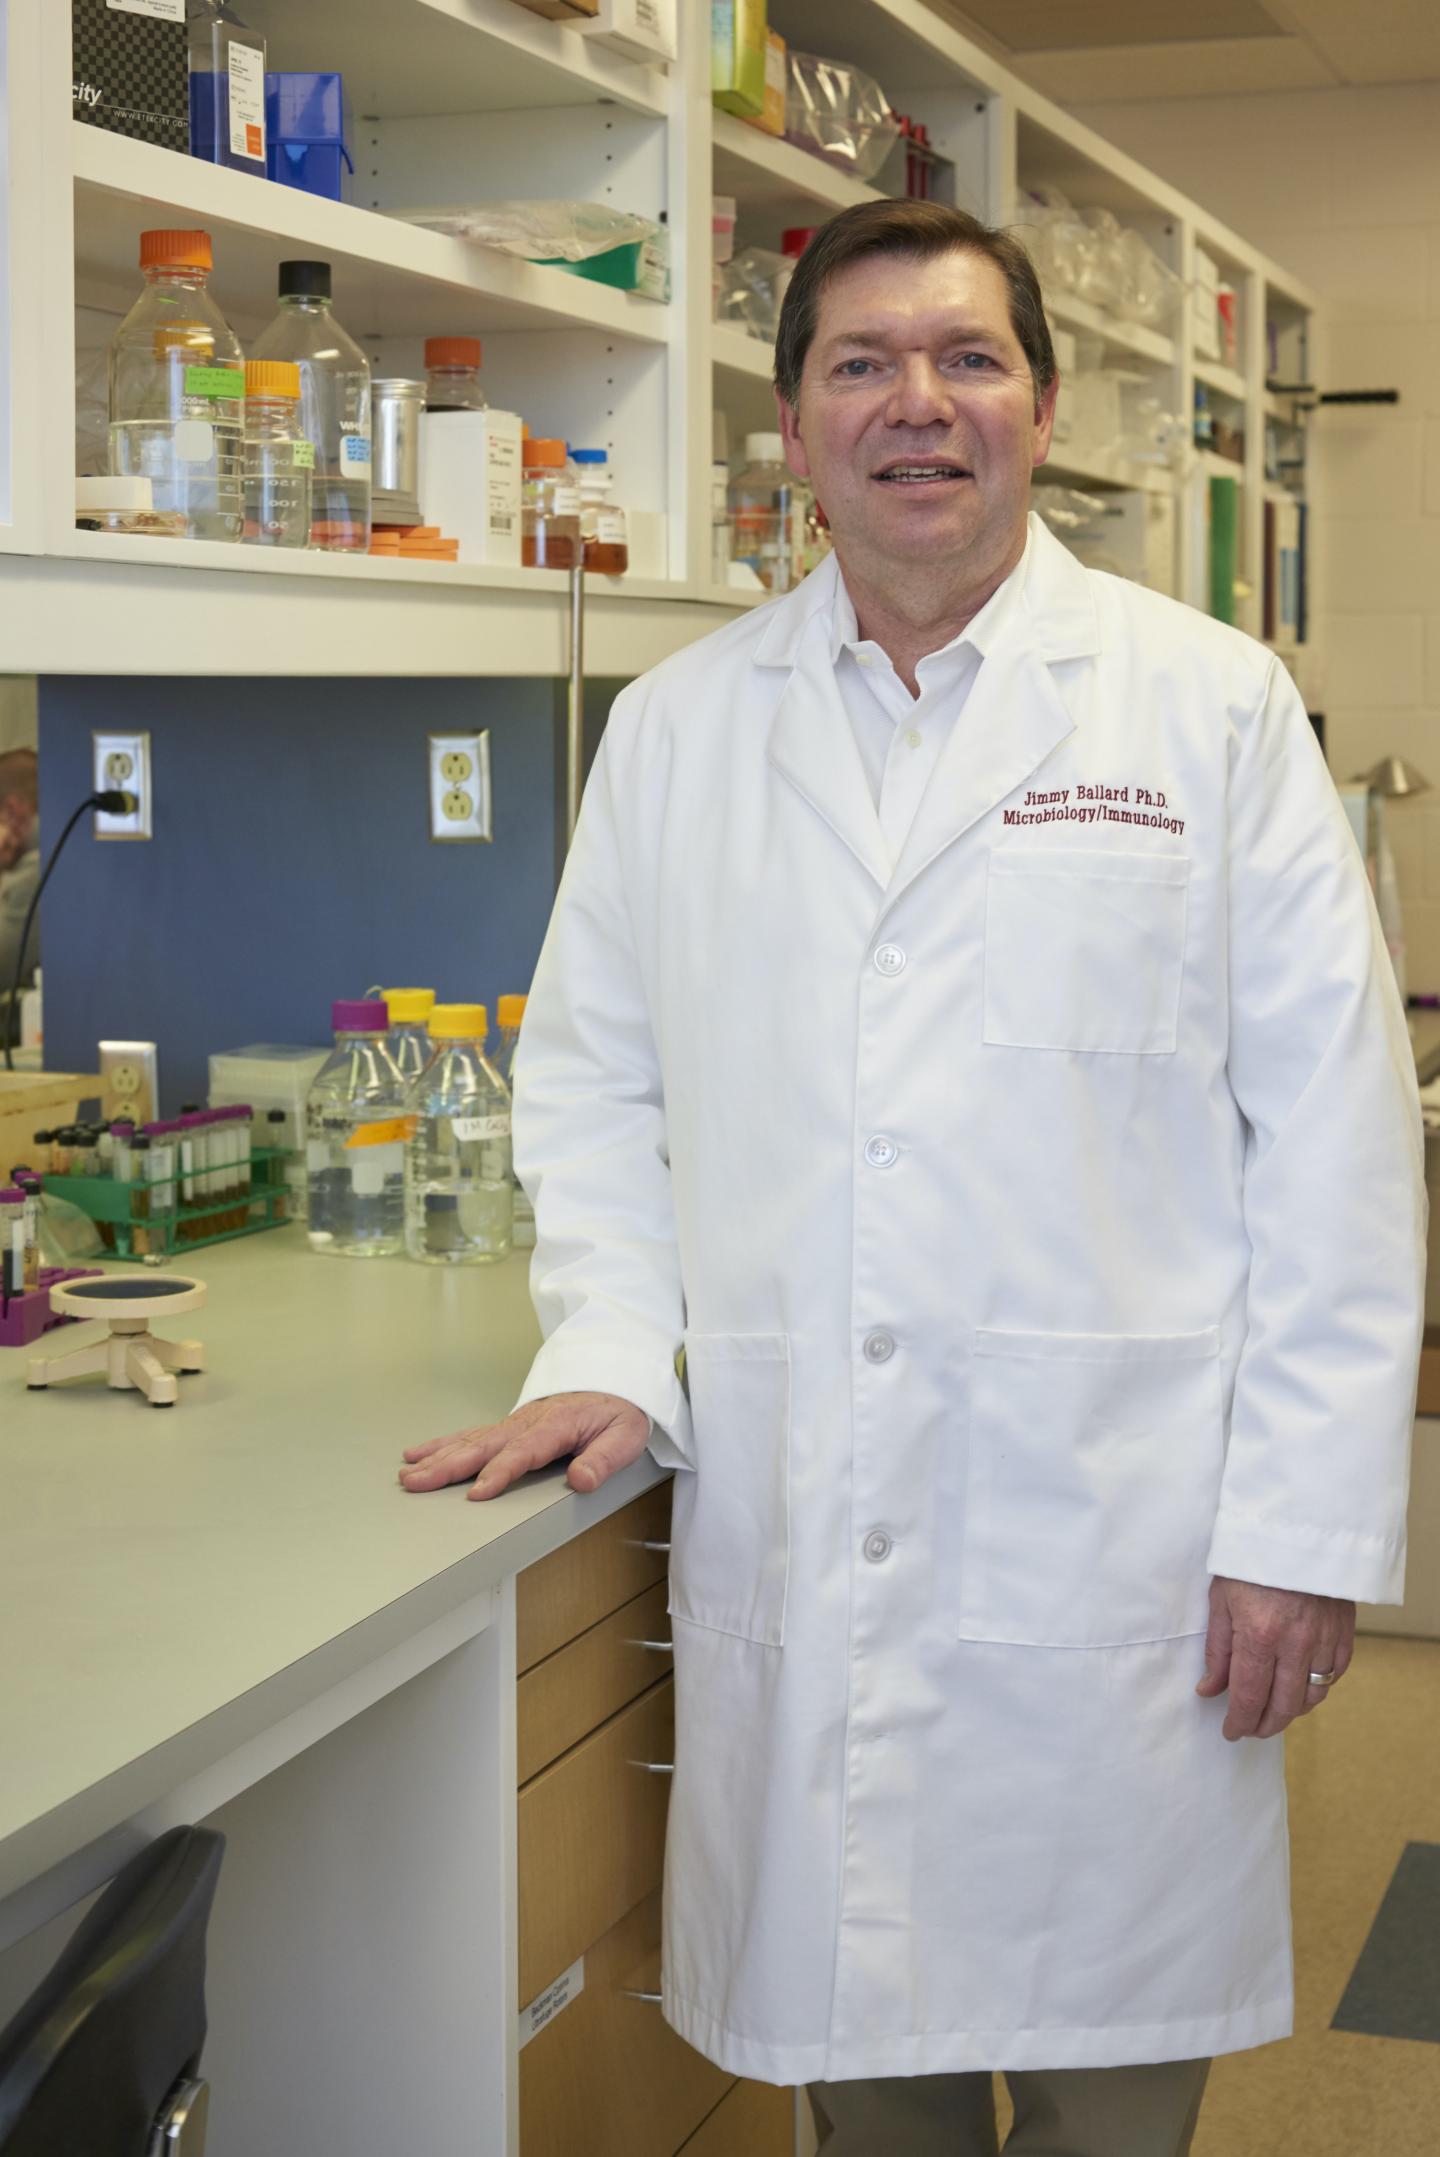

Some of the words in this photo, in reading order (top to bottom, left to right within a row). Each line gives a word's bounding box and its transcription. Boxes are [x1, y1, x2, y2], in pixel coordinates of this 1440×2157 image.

[73, 82, 102, 106] city
[1024, 789, 1069, 807] Jimmy
[1076, 785, 1129, 802] Ballard
[1136, 788, 1168, 809] Ph.D.
[1003, 804, 1185, 835] Microbiology/Immunology
